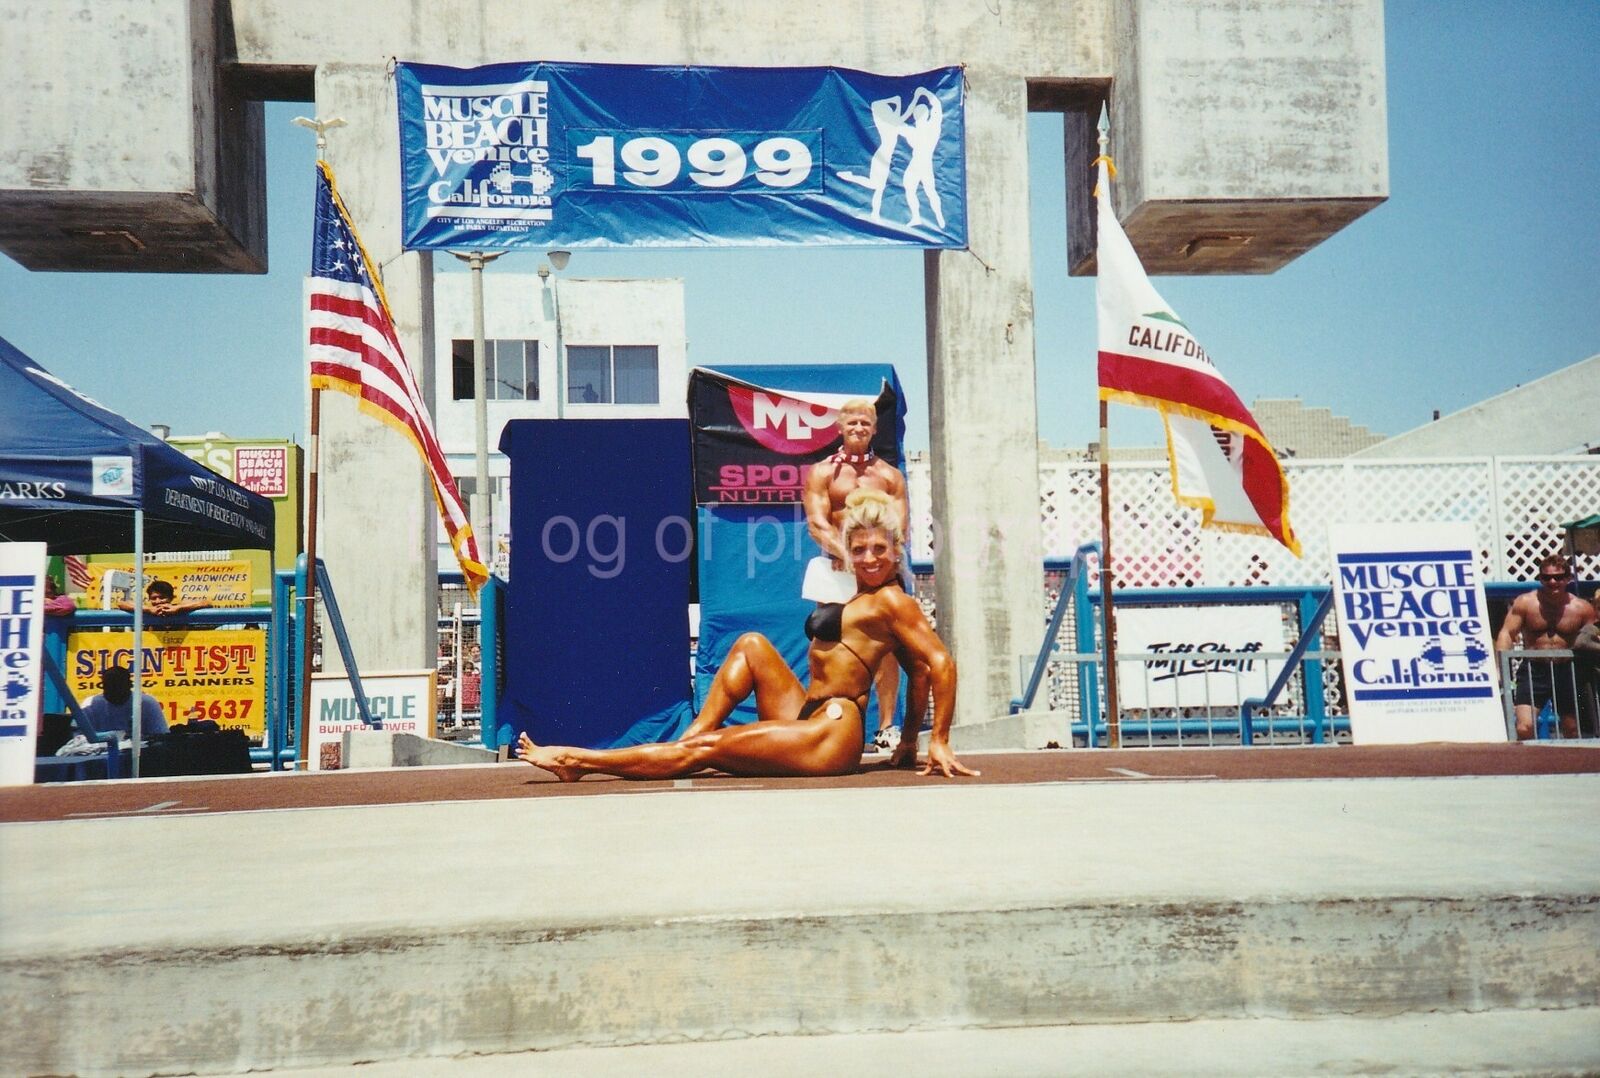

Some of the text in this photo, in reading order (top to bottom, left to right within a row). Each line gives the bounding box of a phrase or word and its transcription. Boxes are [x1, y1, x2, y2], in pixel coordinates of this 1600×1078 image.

[423, 92, 548, 121] MUSCLE
[425, 117, 548, 149] BEACH
[426, 146, 550, 178] Venice
[577, 136, 811, 188] 1999
[428, 179, 552, 208] California
[1128, 325, 1216, 368] CALIFOR
[239, 450, 283, 459] MUSCLE
[239, 458, 283, 468] BEACH
[239, 468, 283, 480] VENICE
[0, 482, 66, 499] ARKS
[181, 584, 211, 592] CORN
[182, 573, 248, 583] SANDWICHES
[1339, 563, 1475, 590] MUSCLE
[212, 593, 247, 601] JUICES
[1343, 589, 1479, 620] BEACH
[1348, 619, 1482, 651] Venice
[165, 677, 255, 688] BANNERS
[1353, 657, 1490, 687] California
[161, 700, 253, 721] 1-5637
